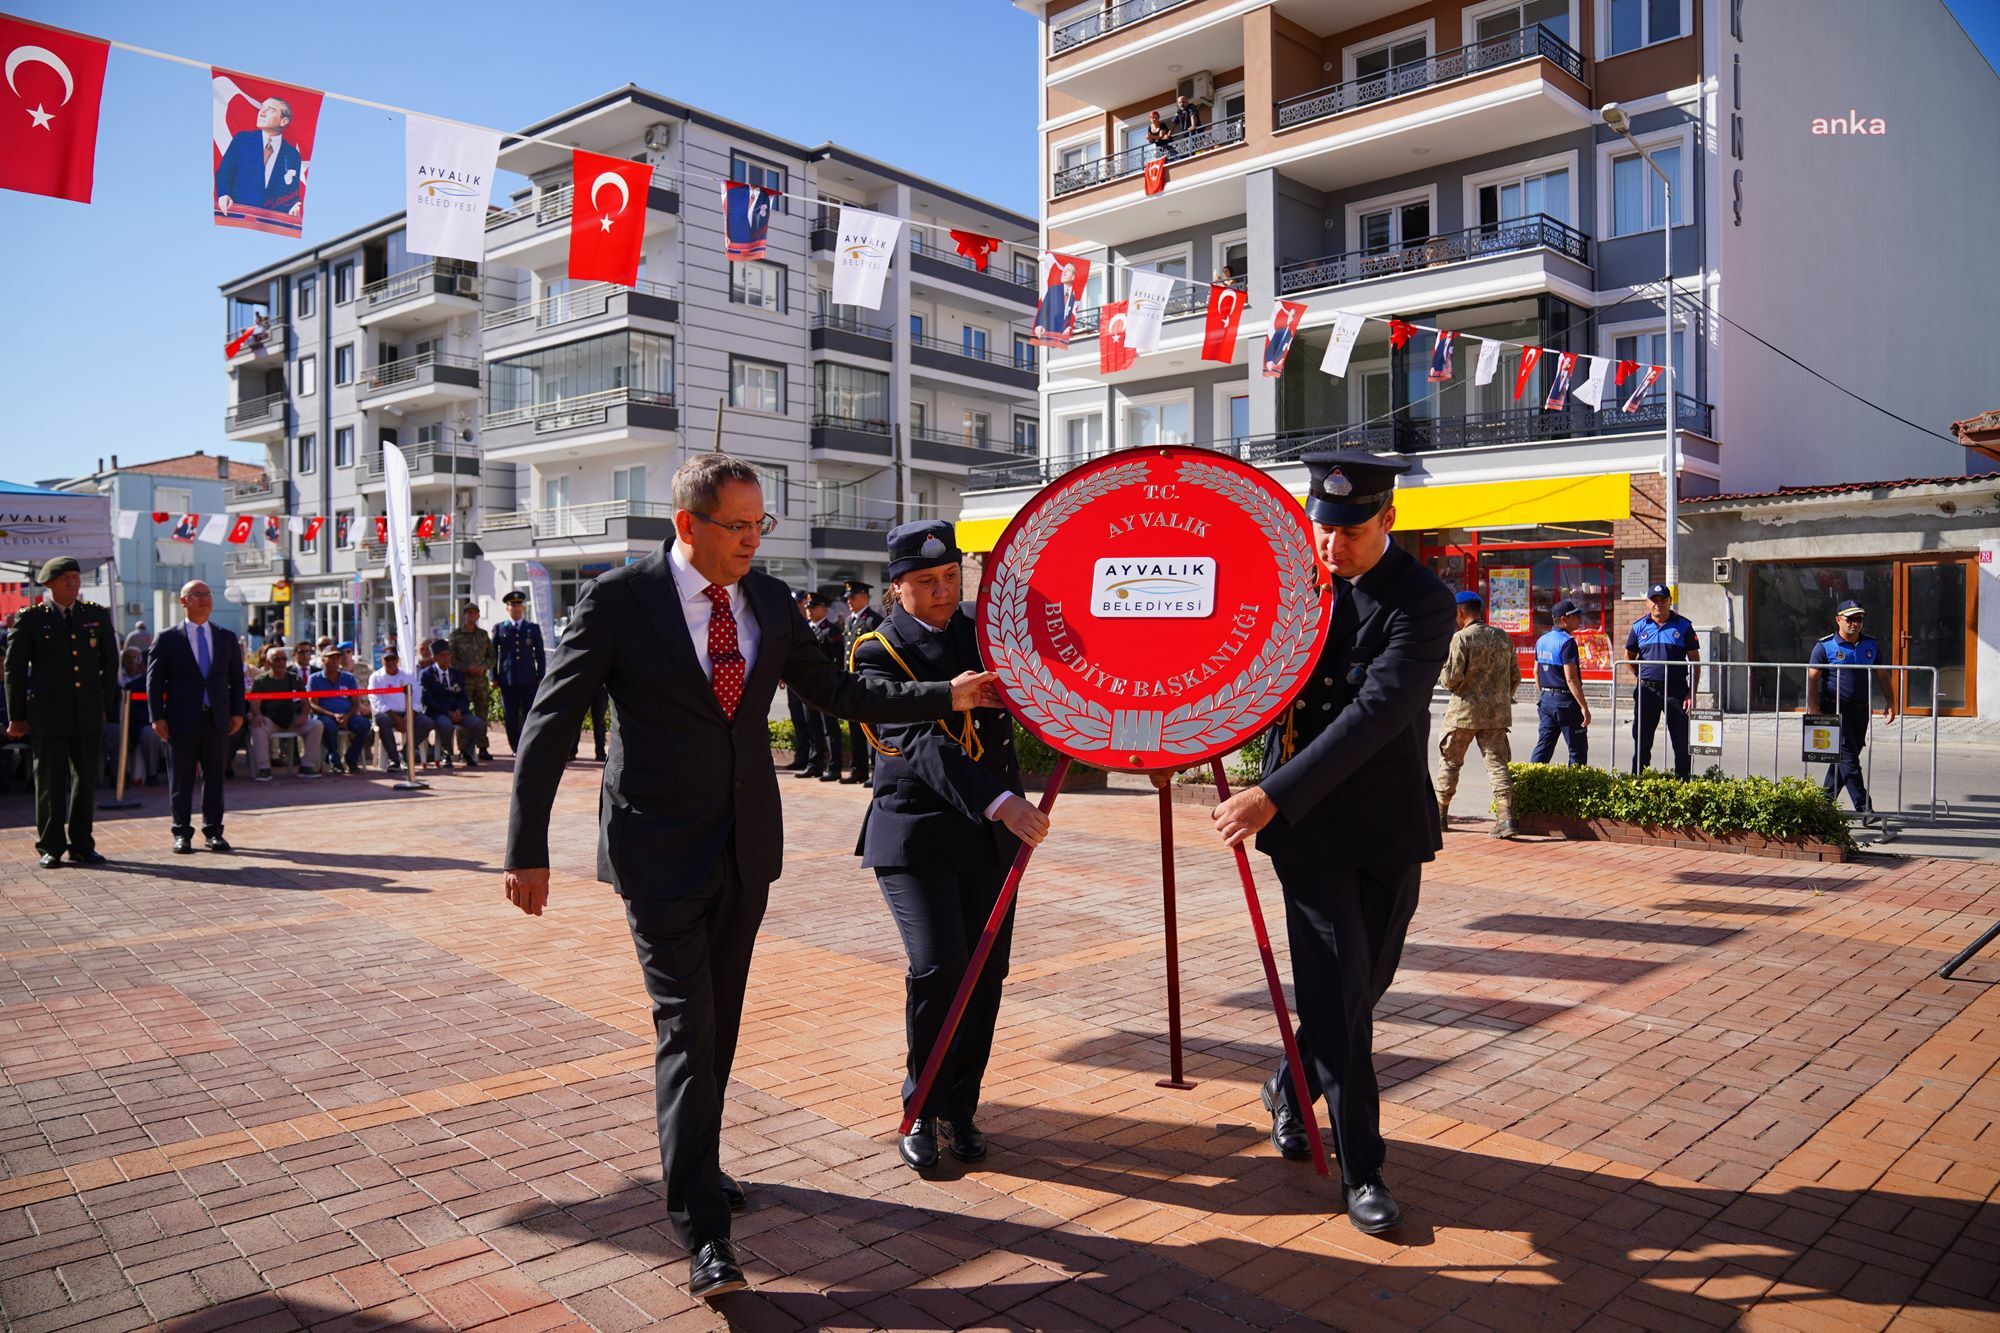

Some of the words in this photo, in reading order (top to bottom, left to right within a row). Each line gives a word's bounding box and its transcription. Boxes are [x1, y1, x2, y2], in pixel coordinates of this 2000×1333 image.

[418, 165, 481, 186] AYVALIK
[844, 234, 887, 249] AYVIK
[1143, 484, 1180, 500] T.C.
[1108, 511, 1212, 539] AYVALIK
[1105, 564, 1205, 576] AYVALIK
[1102, 600, 1202, 611] BELEDİYESİ
[1044, 600, 1128, 696] BELEDİYE
[1132, 602, 1259, 697] BAŞKANLIĞI
